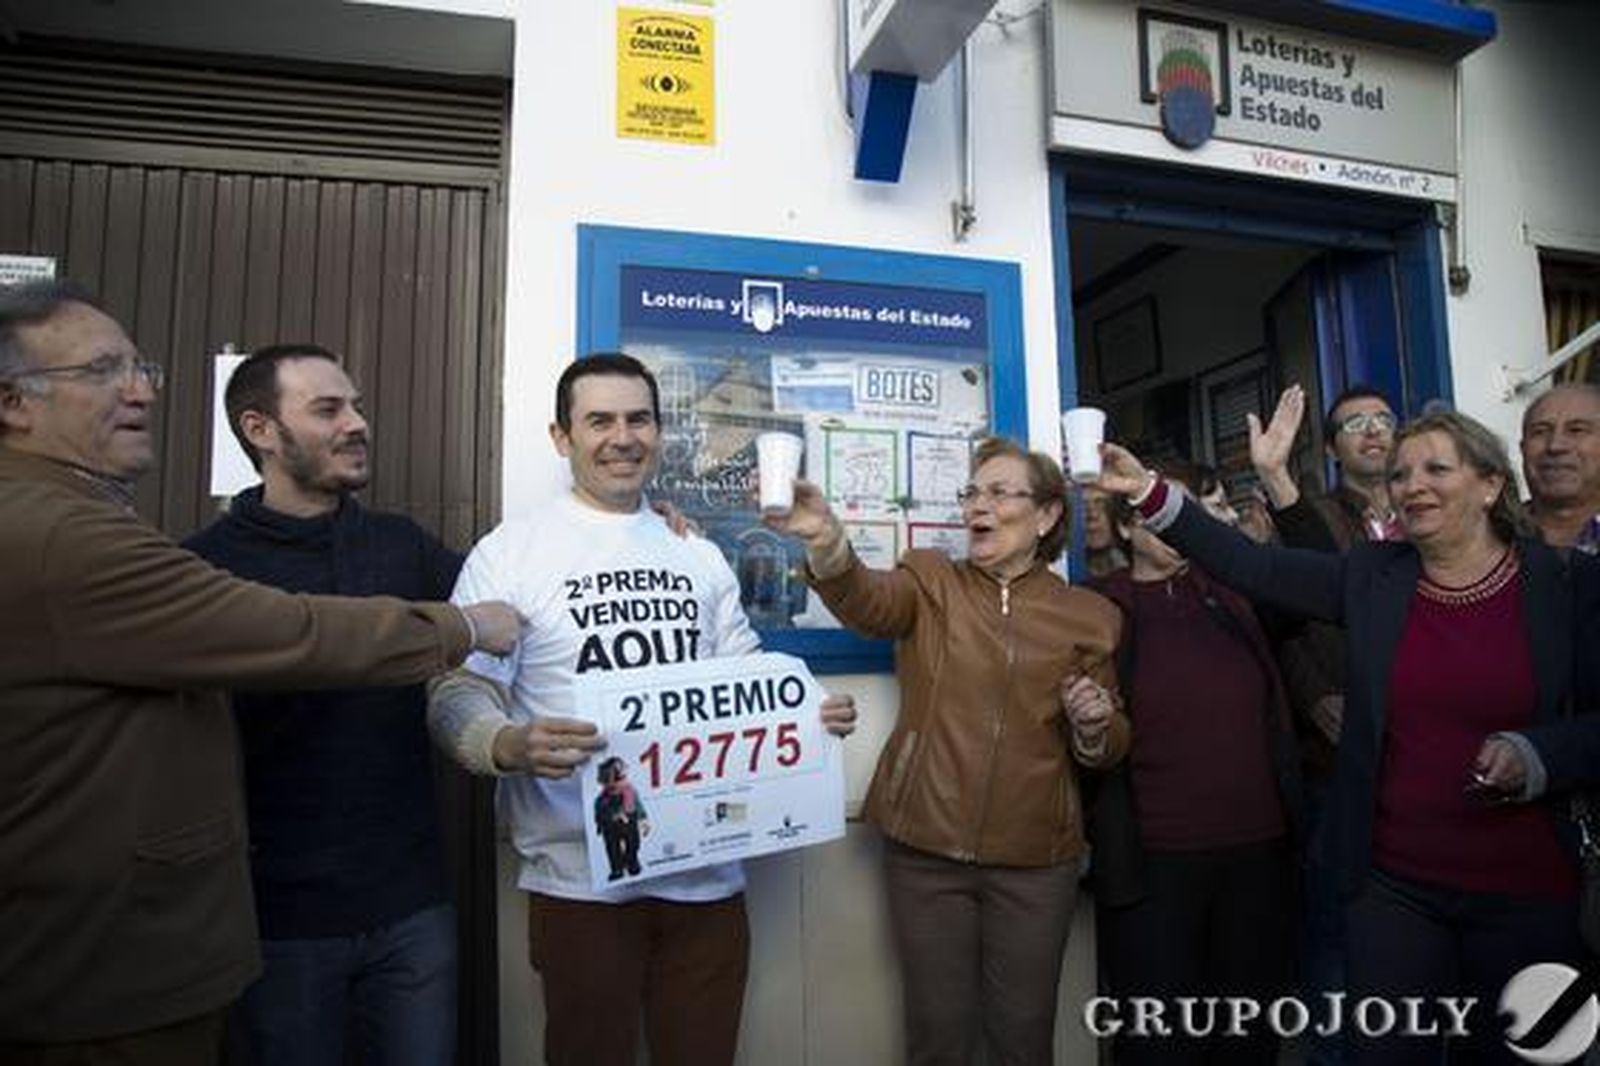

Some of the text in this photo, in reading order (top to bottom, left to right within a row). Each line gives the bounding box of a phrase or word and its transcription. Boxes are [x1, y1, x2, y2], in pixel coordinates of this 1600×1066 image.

[630, 37, 701, 55] CONECTADA
[636, 25, 696, 41] ALARMA
[1342, 52, 1355, 78] y
[1240, 64, 1384, 110] Apuestas del
[1241, 97, 1322, 132] Estado
[1420, 176, 1432, 193] 2
[730, 299, 744, 316] y
[785, 299, 872, 322] Apuestas
[876, 309, 905, 324] del
[910, 312, 972, 330] Estado
[867, 369, 934, 402] BOTES
[569, 598, 698, 630] VENDIDO
[659, 675, 806, 727] PREMIO
[639, 722, 801, 789] 12775
